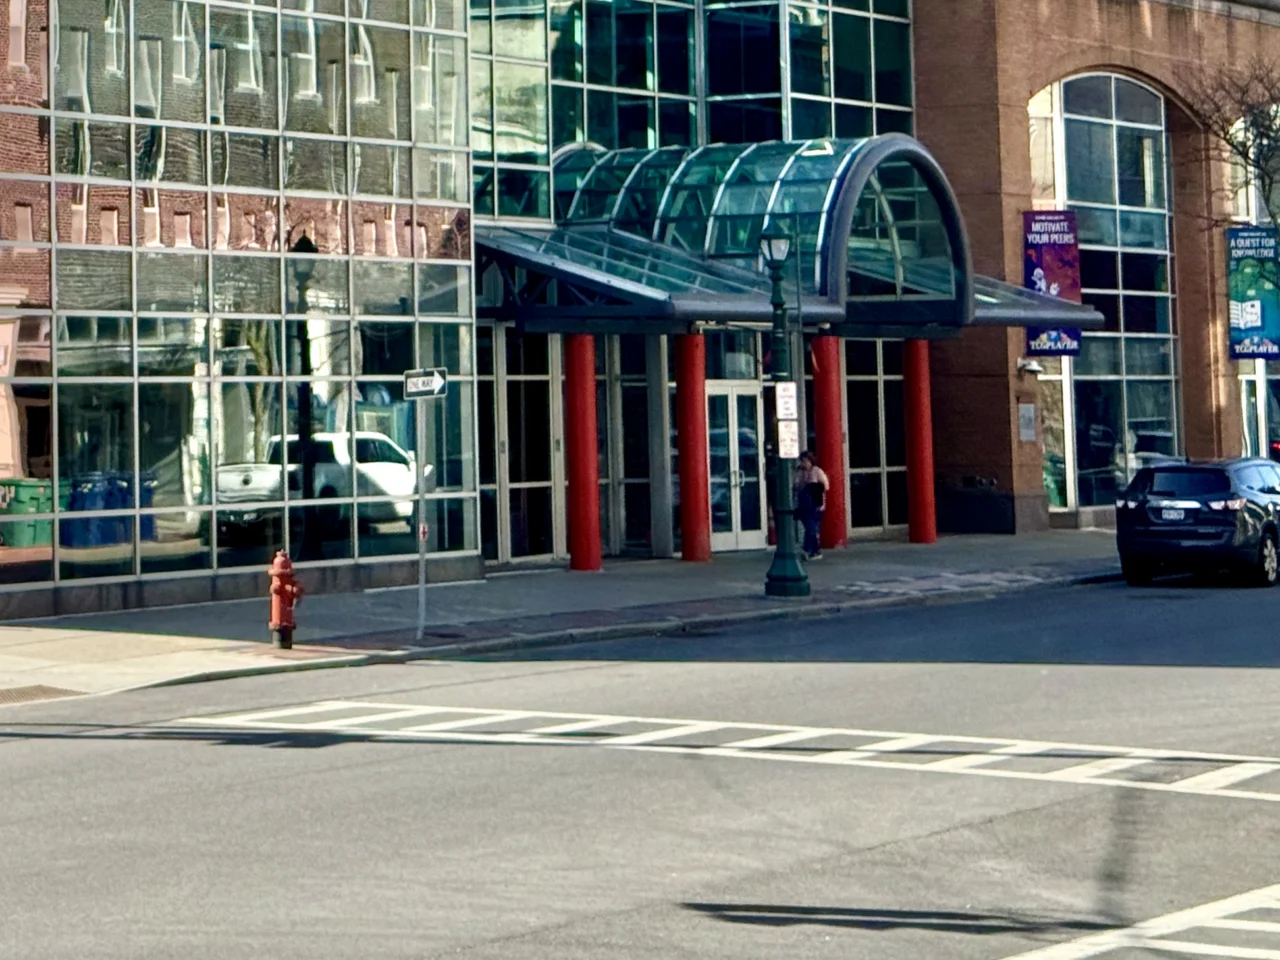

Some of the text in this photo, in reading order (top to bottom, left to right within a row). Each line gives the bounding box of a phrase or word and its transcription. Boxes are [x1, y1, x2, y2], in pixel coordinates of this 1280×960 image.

[1031, 222, 1069, 233] MOTIVATE
[1026, 233, 1075, 244] YOUR PEERS
[1230, 237, 1276, 248] A QUEST FOR
[1231, 248, 1275, 259] KNOWLEDGE
